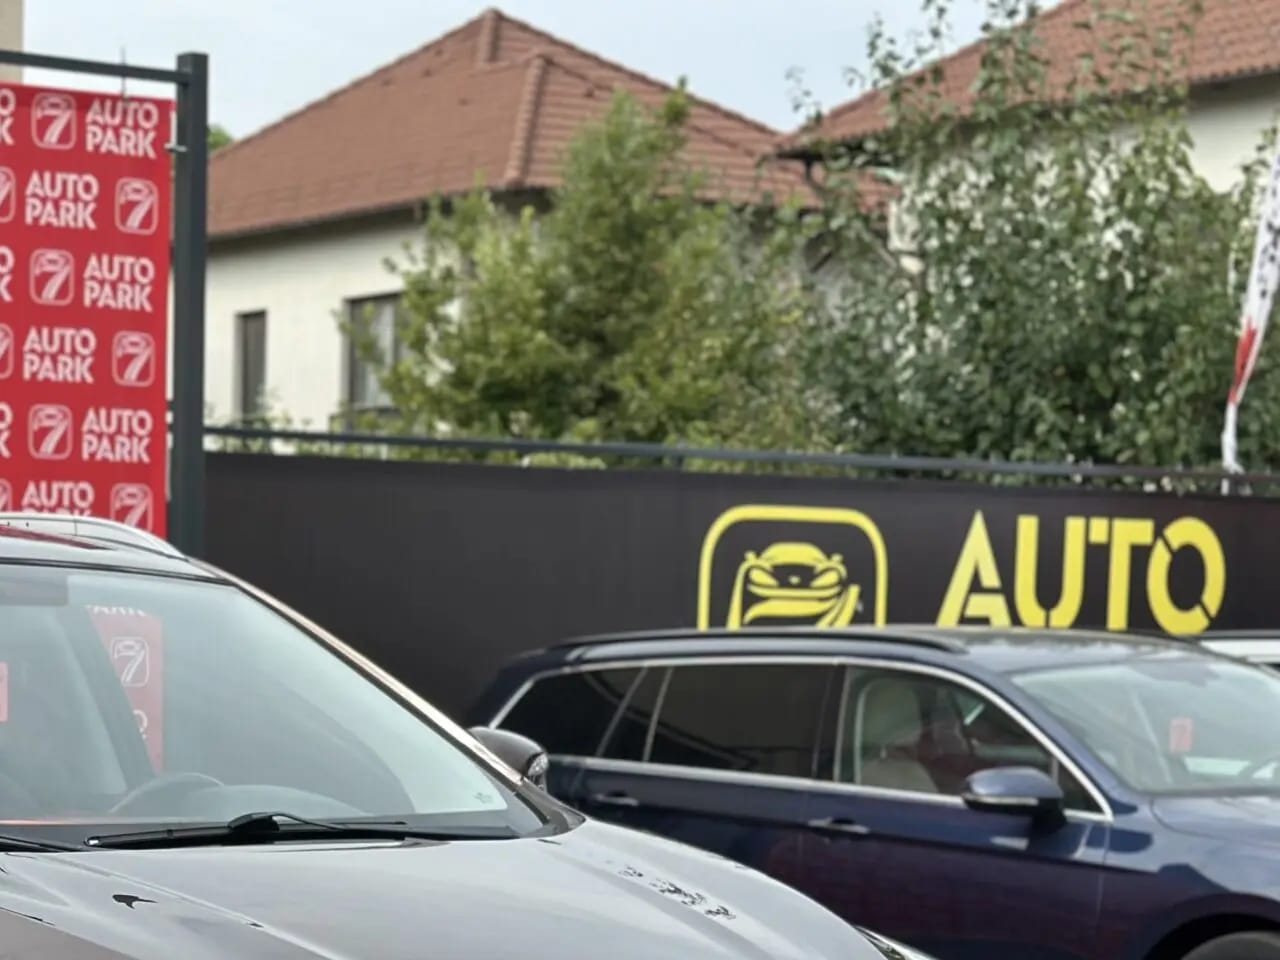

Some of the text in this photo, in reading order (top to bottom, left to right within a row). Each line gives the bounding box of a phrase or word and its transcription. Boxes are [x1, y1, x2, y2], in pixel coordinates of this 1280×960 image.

[86, 95, 159, 129] AUTO
[86, 124, 155, 158] PARK
[26, 171, 98, 201] AUTO
[25, 197, 96, 229] PARK
[84, 254, 154, 284] AUTO
[84, 280, 152, 312] PARK
[23, 327, 96, 355] AUTO
[23, 353, 93, 383] PARK
[82, 408, 152, 436] AUTO
[82, 432, 149, 462] PARK
[23, 482, 93, 506] AUTO
[935, 510, 1226, 636] AUTO
